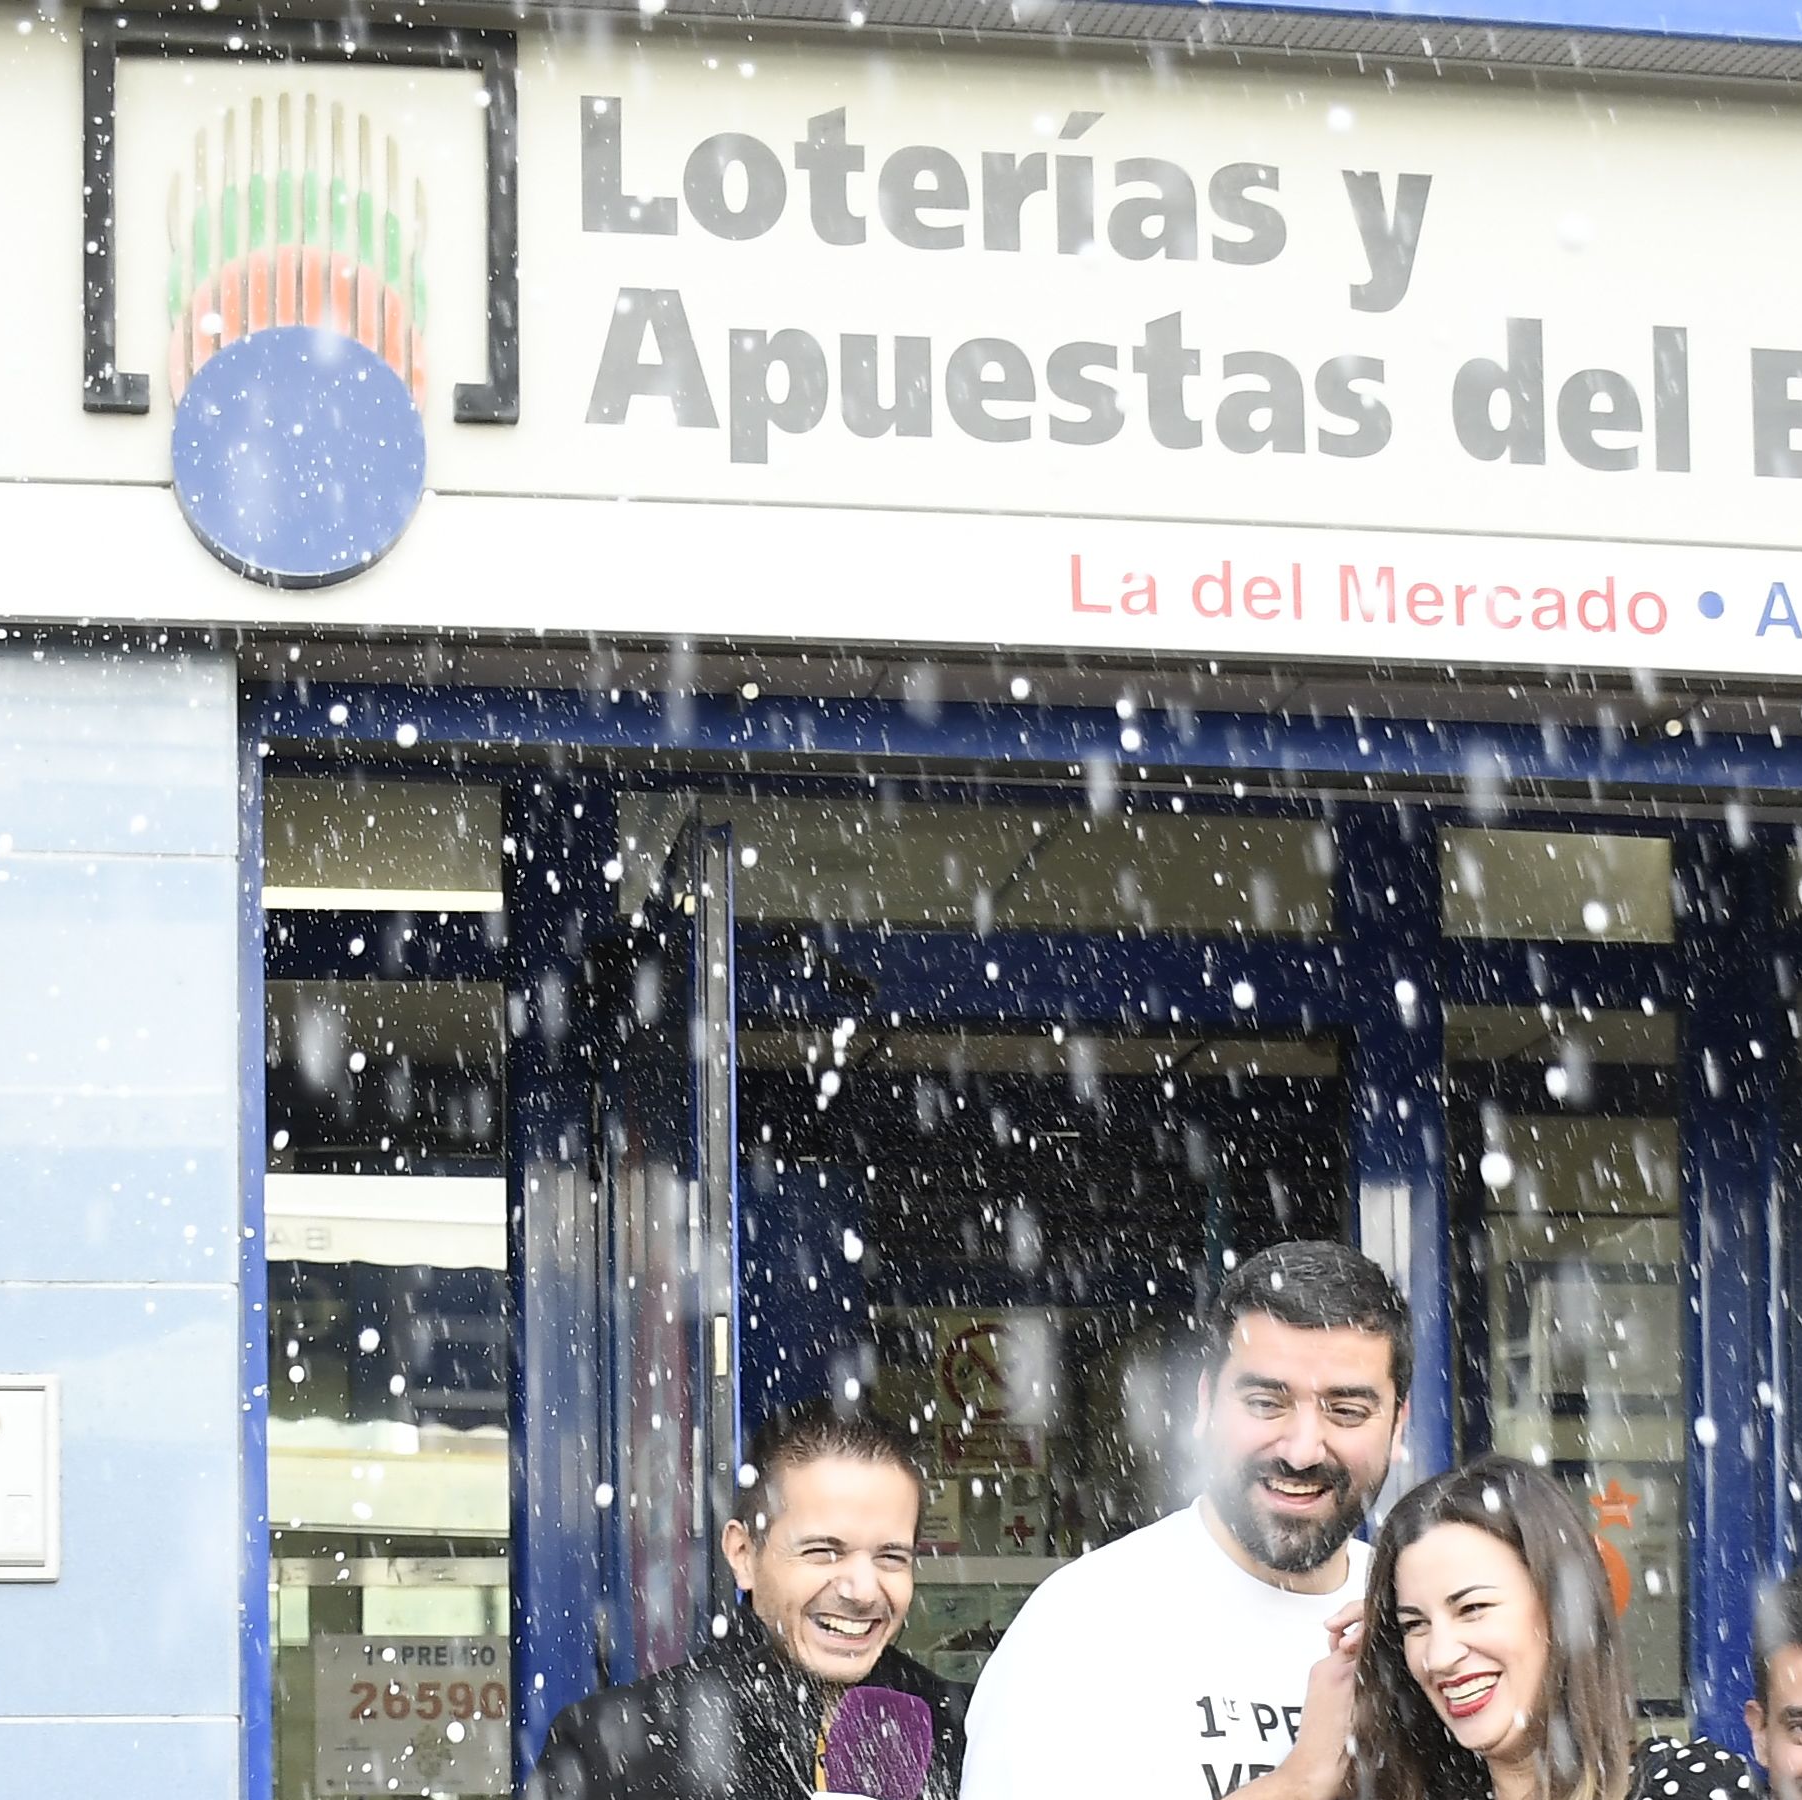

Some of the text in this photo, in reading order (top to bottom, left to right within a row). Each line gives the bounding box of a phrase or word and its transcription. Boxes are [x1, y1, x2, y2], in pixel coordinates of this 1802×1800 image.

[579, 94, 1434, 312] Loterías y
[583, 286, 1394, 465] Apuestas
[1451, 316, 1692, 475] del
[1070, 553, 1158, 616] La
[1191, 559, 1302, 621] del
[1338, 563, 1668, 636] Mercado
[349, 1680, 508, 1720] 26590
